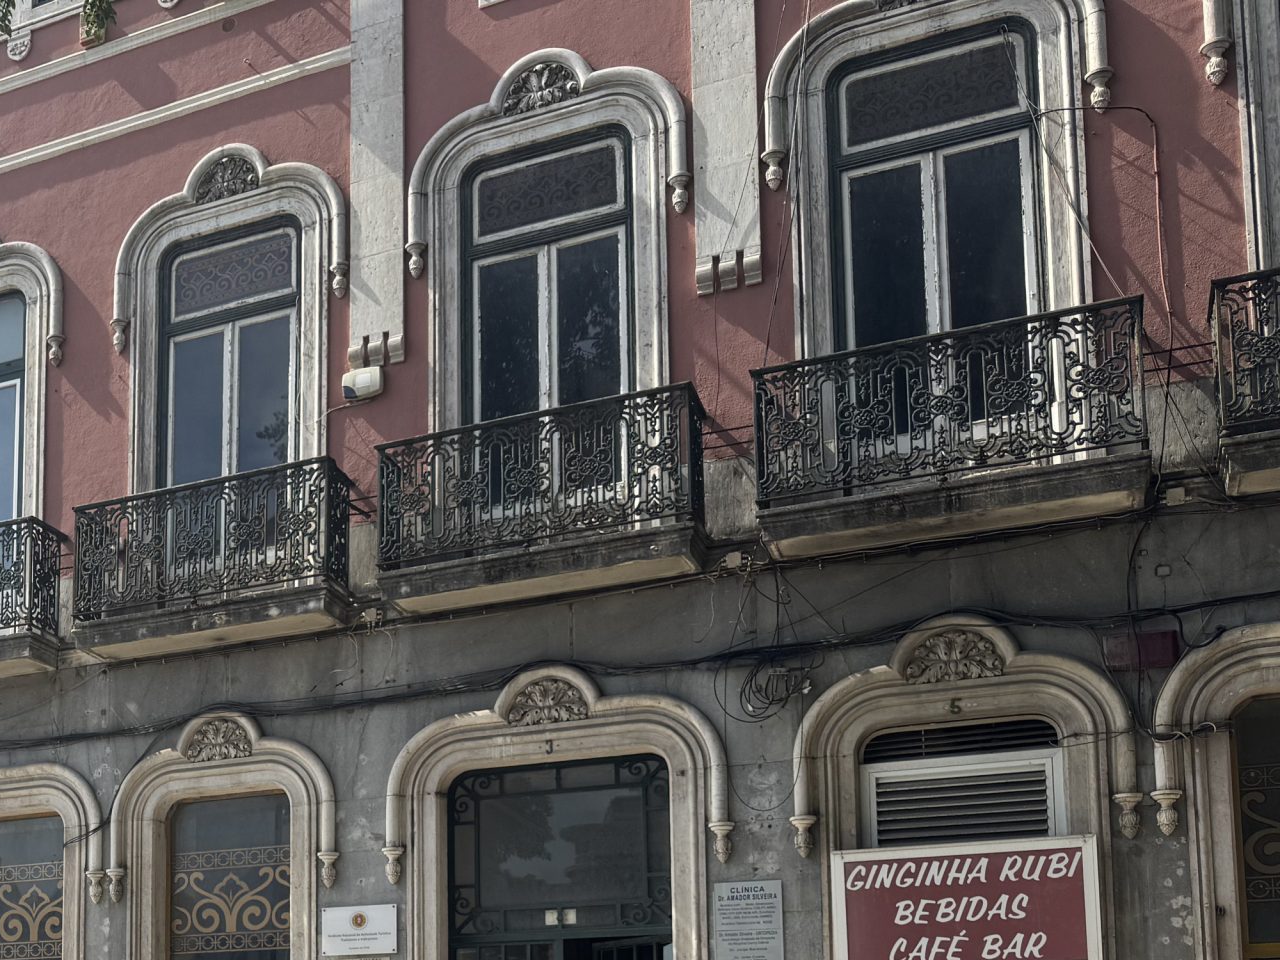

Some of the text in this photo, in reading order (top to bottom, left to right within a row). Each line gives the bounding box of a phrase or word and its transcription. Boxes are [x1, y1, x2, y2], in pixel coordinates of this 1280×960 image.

[846, 851, 1082, 891] GINGINHA RUBI
[730, 886, 765, 894] CLÍNICA
[894, 893, 1029, 925] BEBIDAS
[981, 931, 1047, 959] BAR
